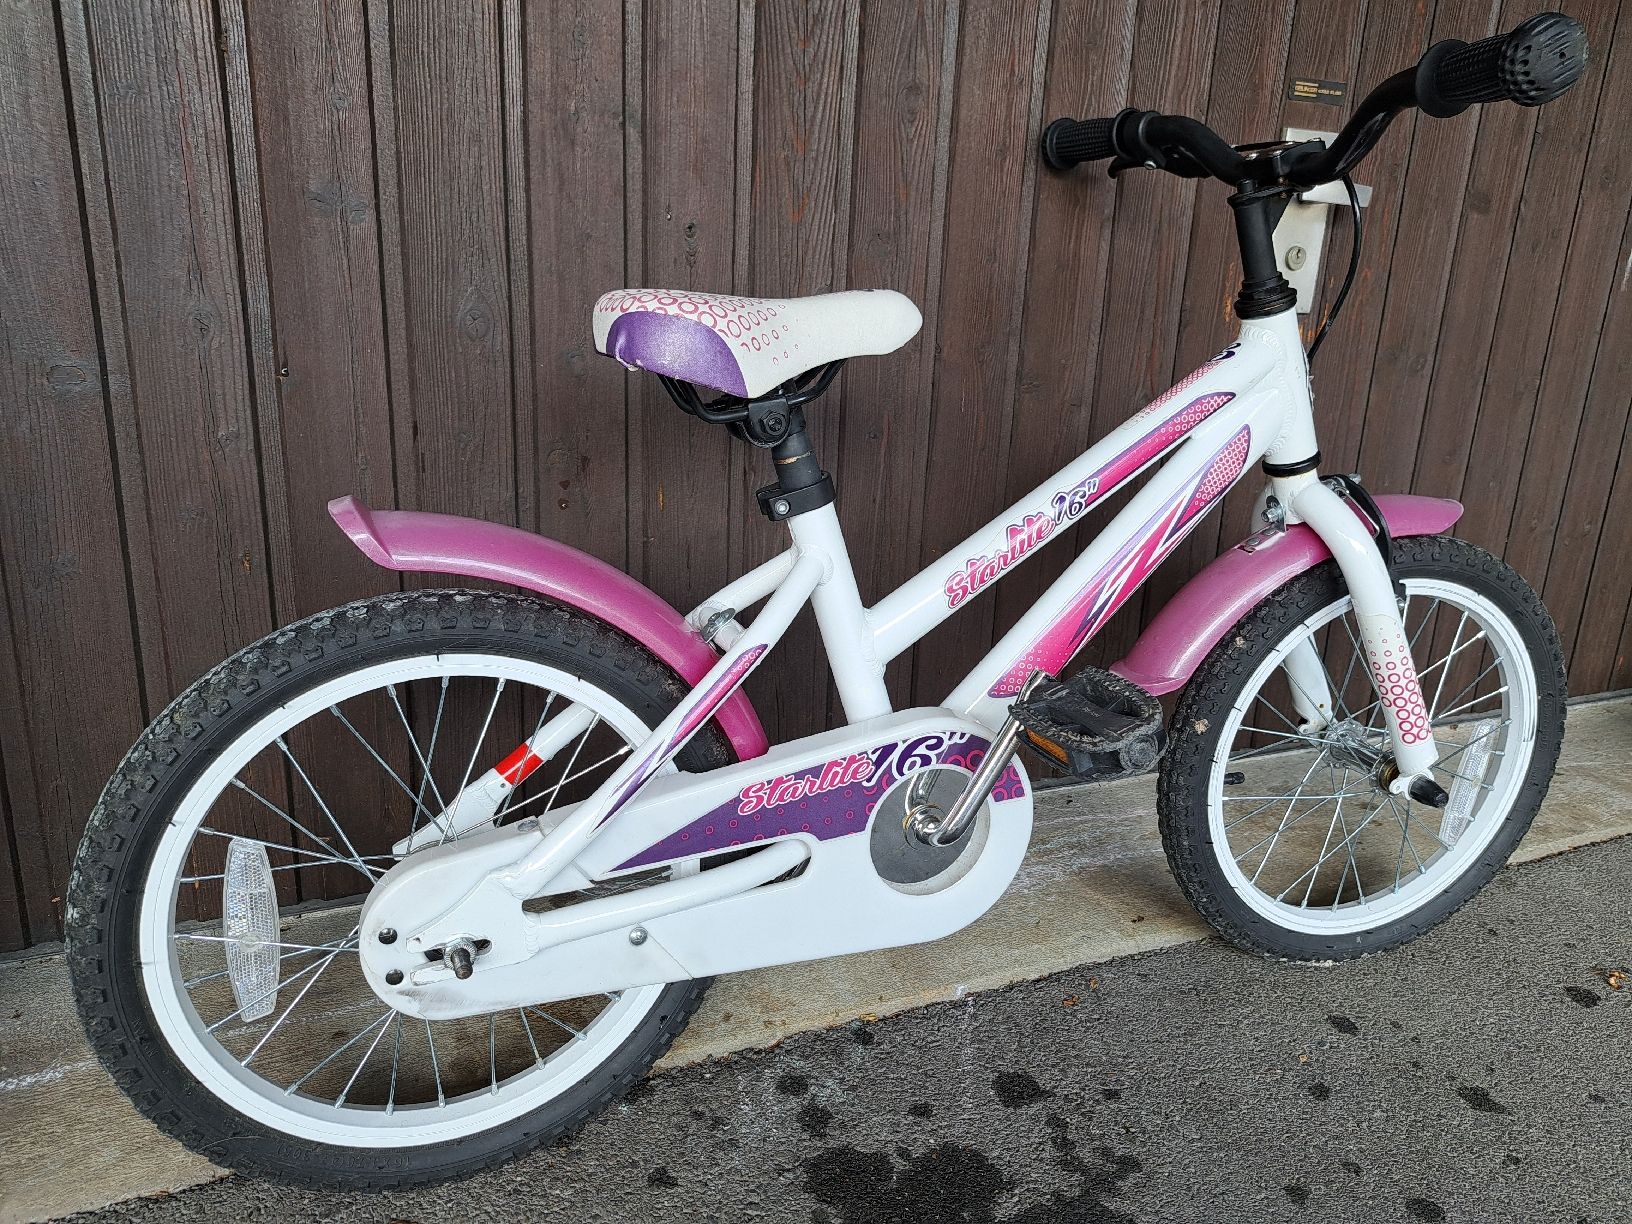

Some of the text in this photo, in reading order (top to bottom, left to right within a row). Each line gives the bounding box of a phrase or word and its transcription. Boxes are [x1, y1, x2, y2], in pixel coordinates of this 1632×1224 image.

[944, 479, 1099, 609] Starlite 16"
[738, 754, 875, 816] Starlite
